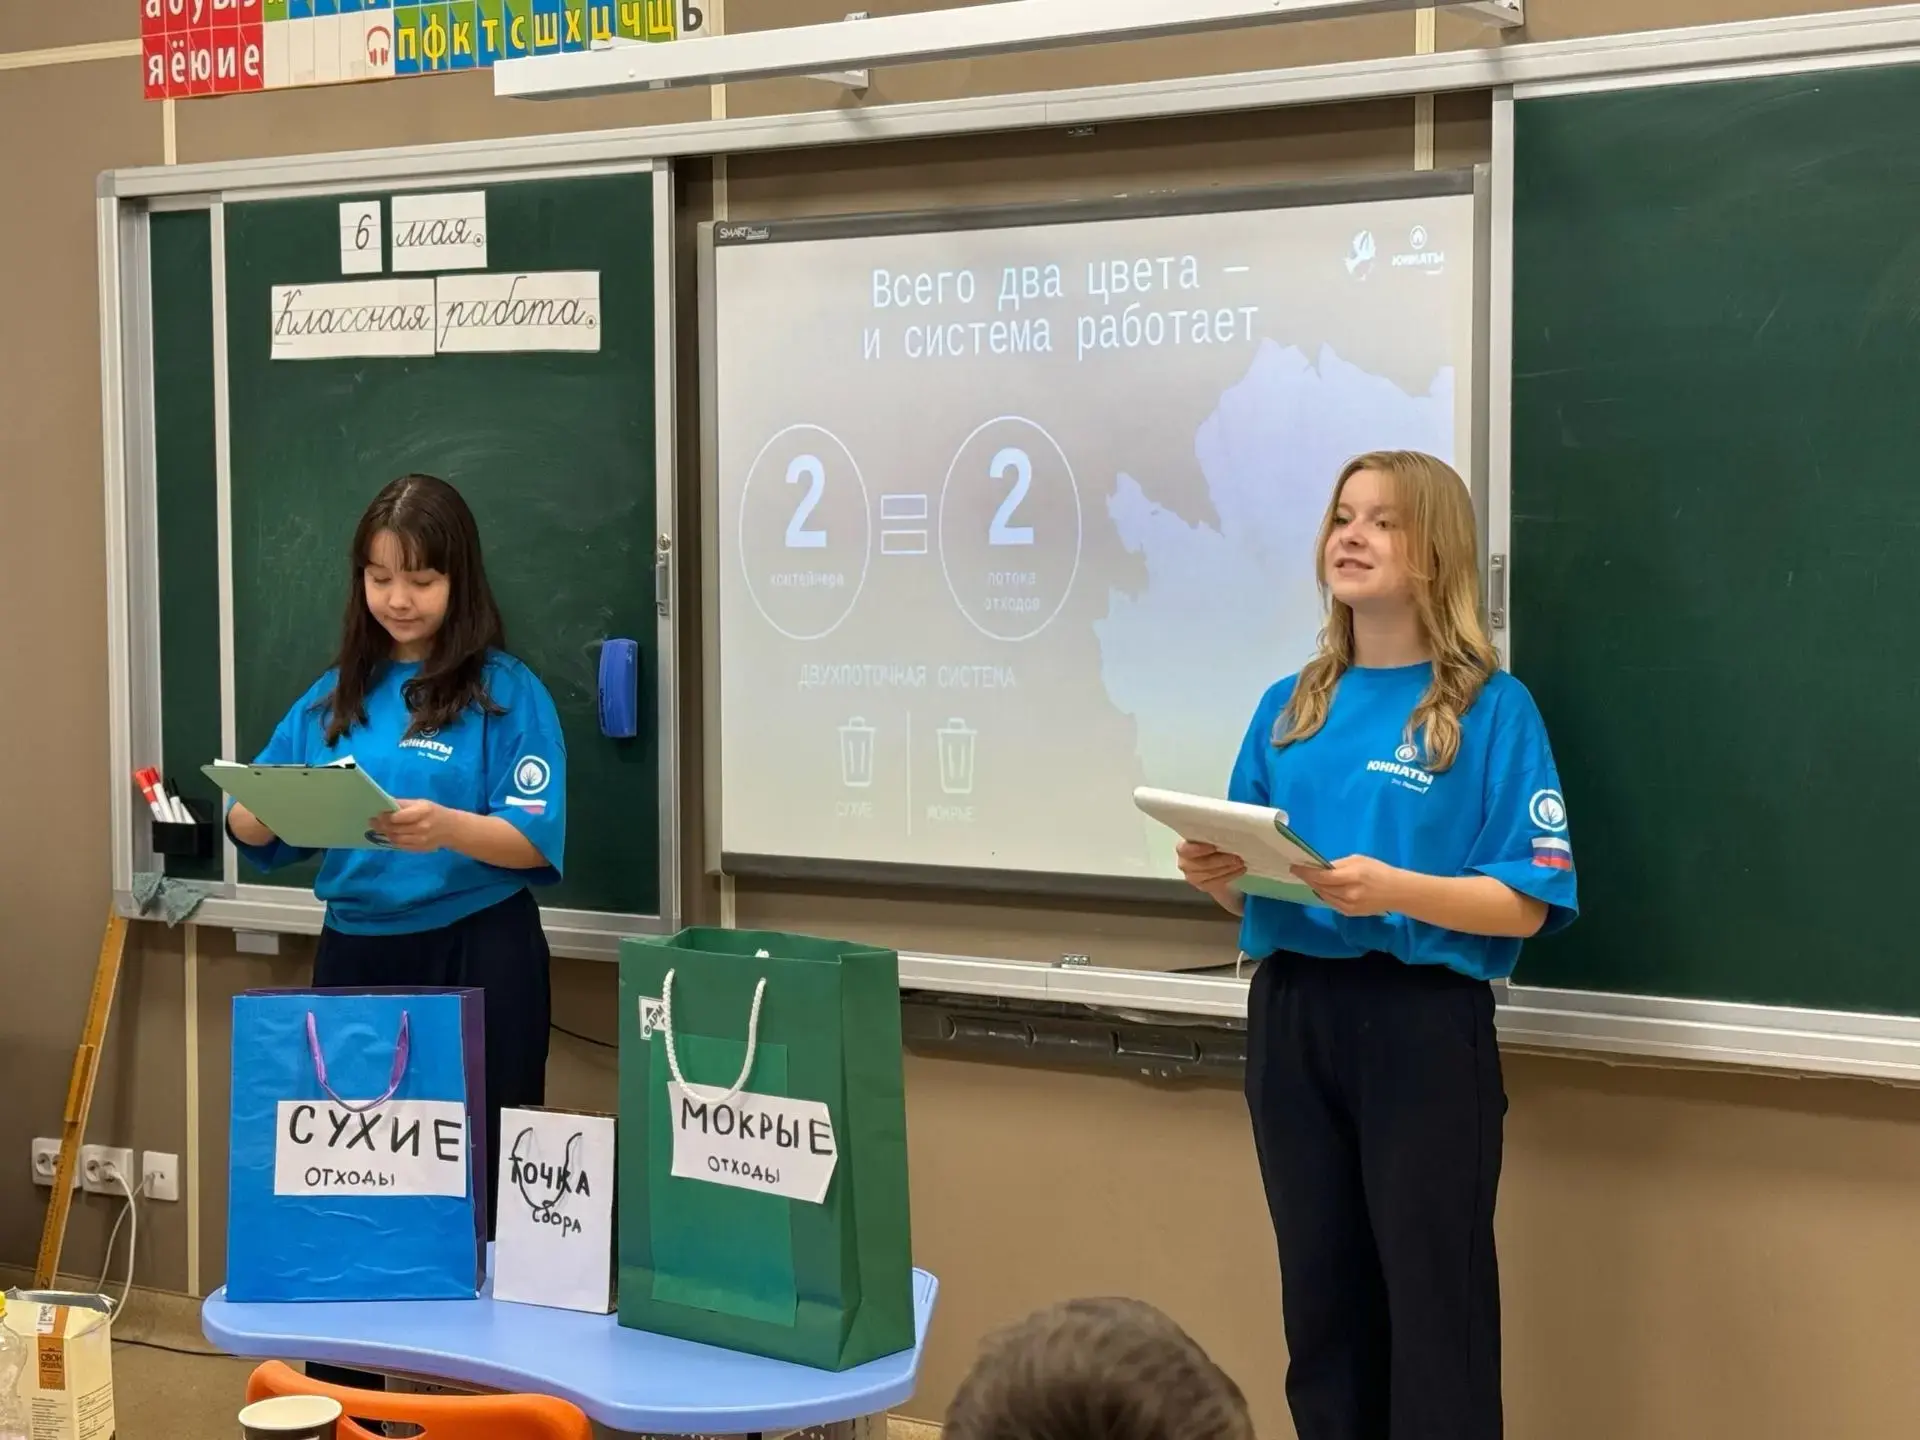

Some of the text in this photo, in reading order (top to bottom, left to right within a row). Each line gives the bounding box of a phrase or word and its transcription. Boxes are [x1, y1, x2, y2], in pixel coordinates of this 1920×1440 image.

[354, 214, 373, 250] 6
[872, 268, 975, 309] Всего
[998, 263, 1063, 311] два
[1087, 254, 1200, 299] цвета
[274, 288, 431, 336] Классная
[862, 302, 1260, 361] и система работает
[785, 454, 827, 548] 2
[988, 447, 1035, 546] 2
[769, 570, 845, 590] контейнера
[987, 571, 1037, 587] потока
[984, 596, 1041, 613] отходов
[798, 663, 1017, 692] ДВУХПОТОЧНАЯ СИСТЕМА
[1366, 760, 1434, 785] ЮННАТЫ
[289, 1104, 463, 1162] СУХИЕ
[681, 1097, 833, 1156] МОКРЫЕ
[509, 1156, 591, 1197] ТОЧКА
